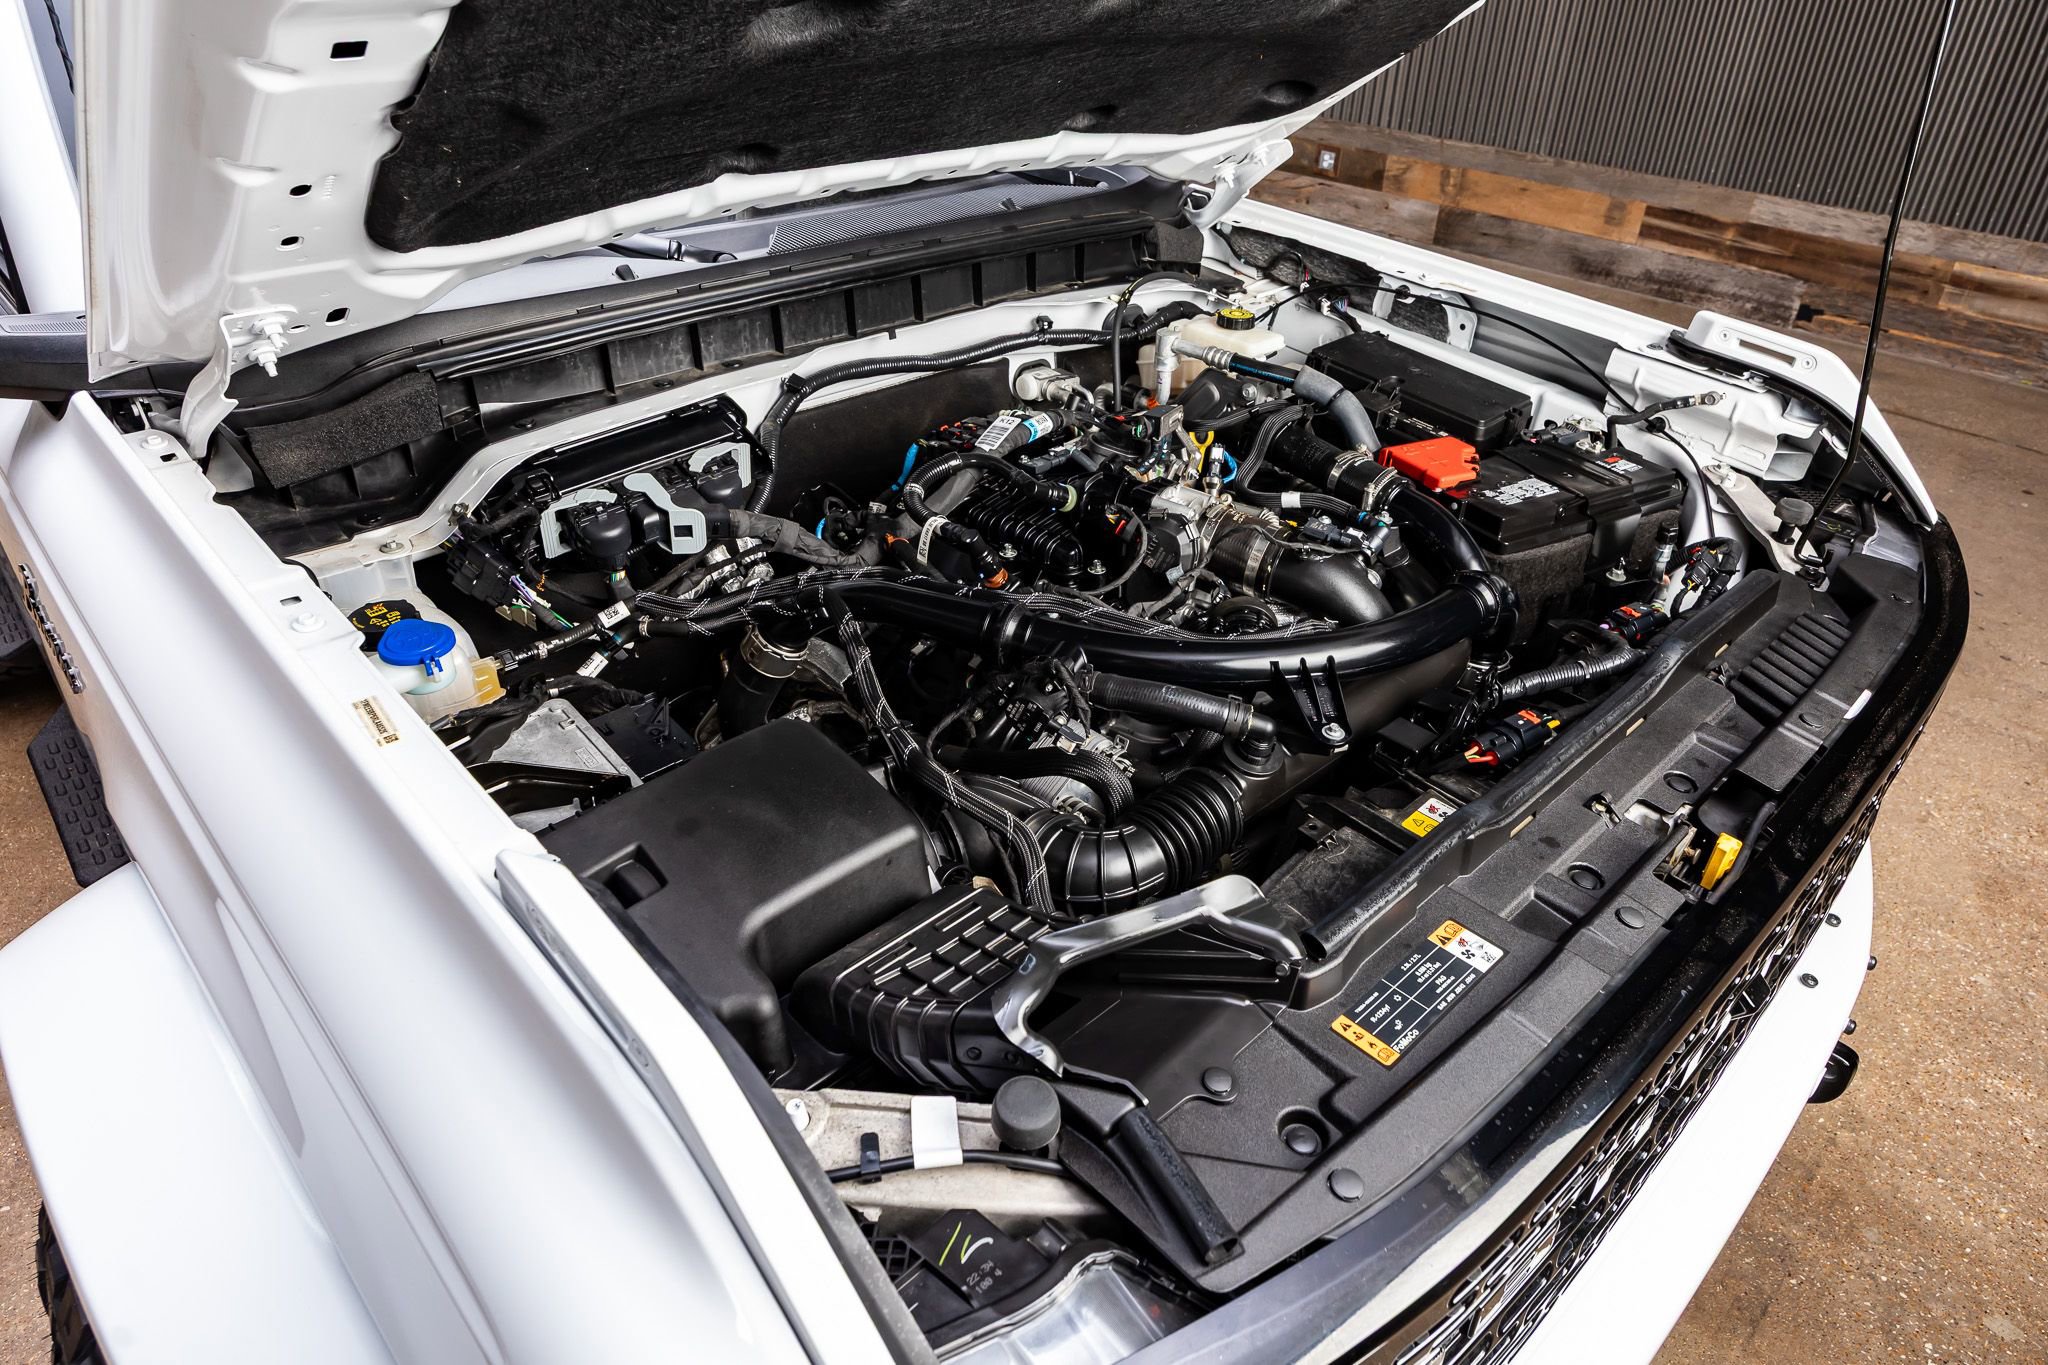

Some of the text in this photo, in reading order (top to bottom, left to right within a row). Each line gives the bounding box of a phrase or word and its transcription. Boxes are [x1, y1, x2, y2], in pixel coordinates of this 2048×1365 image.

[1435, 975, 1447, 985] PAG
[1437, 1001, 1448, 1010] SAE
[1392, 1029, 1420, 1053] FoMoCo
